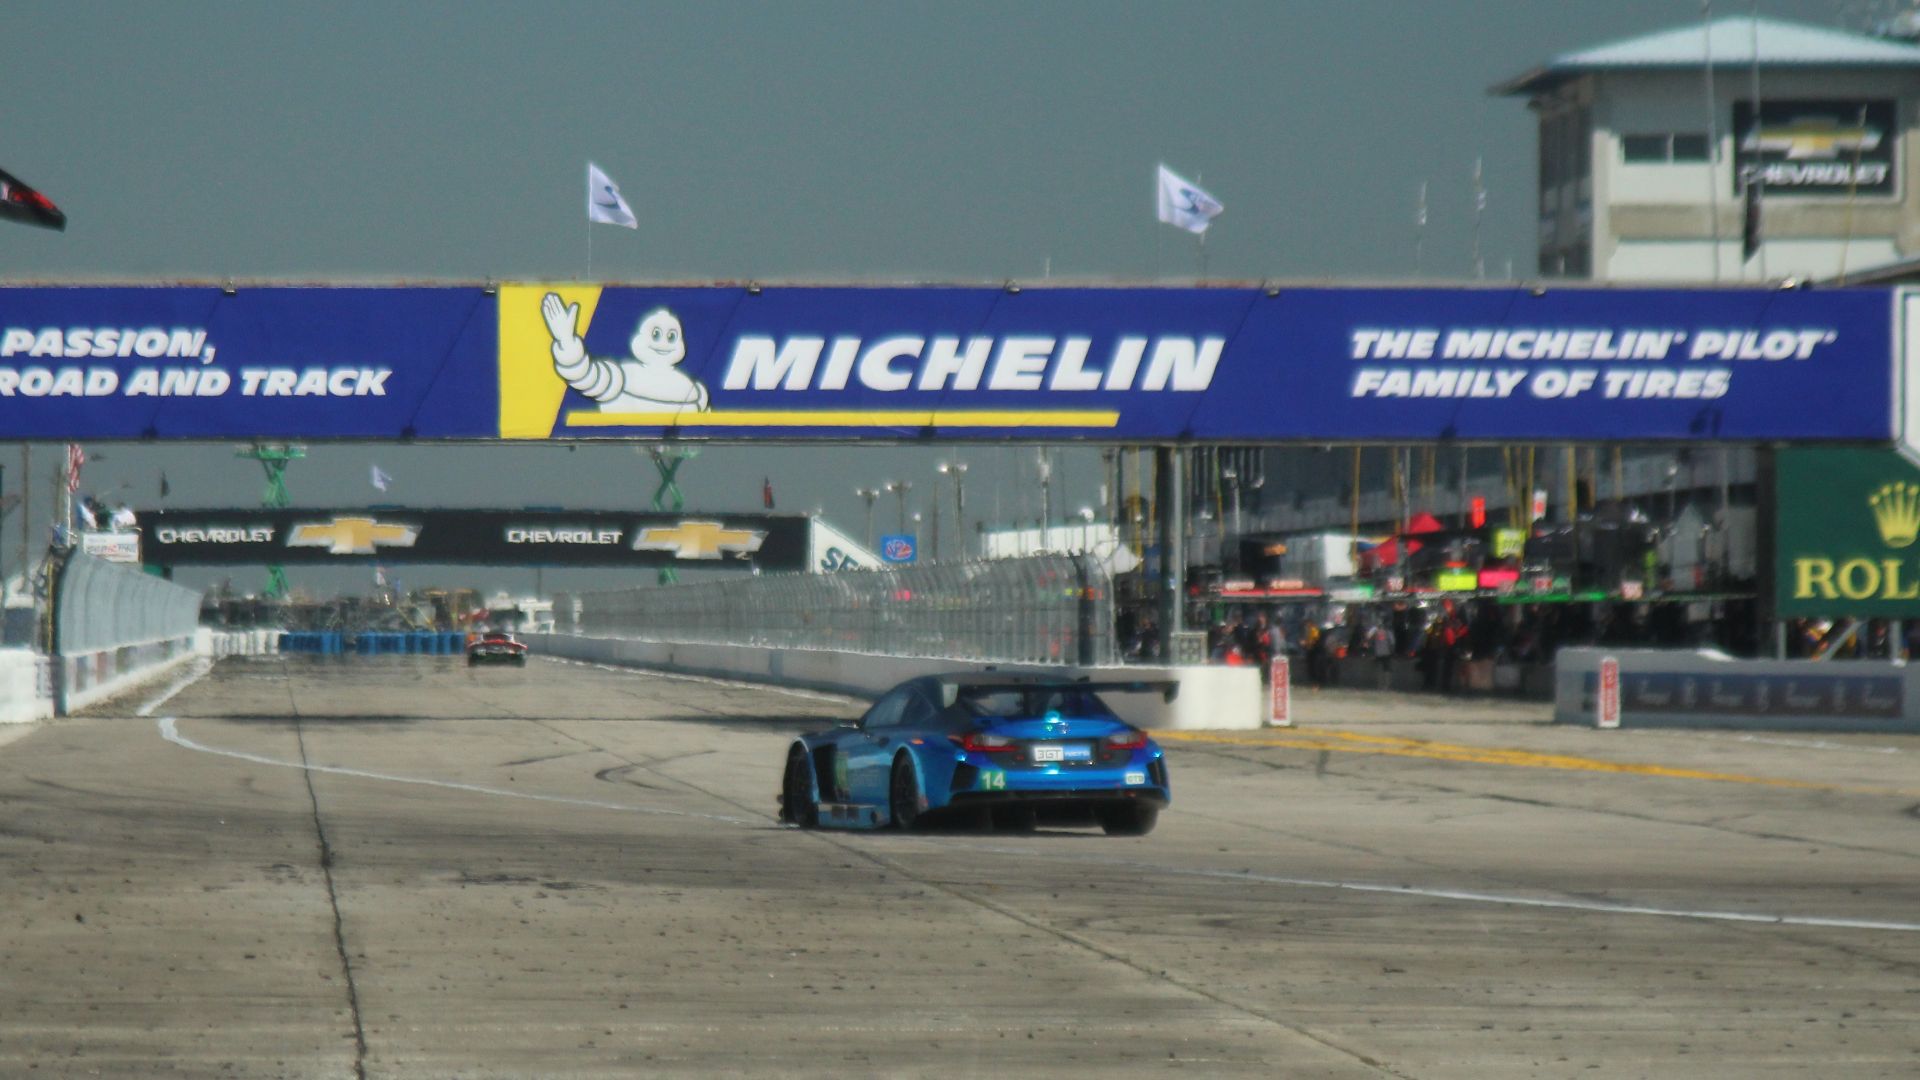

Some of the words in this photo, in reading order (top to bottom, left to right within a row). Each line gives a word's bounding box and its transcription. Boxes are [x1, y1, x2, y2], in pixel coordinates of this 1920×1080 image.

[1, 328, 216, 364] PASSION,
[1351, 330, 1440, 359] THE
[723, 338, 1226, 391] MICHELIN
[0, 368, 119, 396] ROAD
[124, 368, 231, 397] AND
[241, 369, 393, 396] TRACK
[1352, 371, 1527, 397] FAMILY
[1530, 370, 1600, 398] OF
[1604, 371, 1732, 398] TIRES
[158, 528, 275, 543] CHEVROLET
[507, 529, 623, 544] CHEVROLET
[982, 771, 1006, 790] 14
